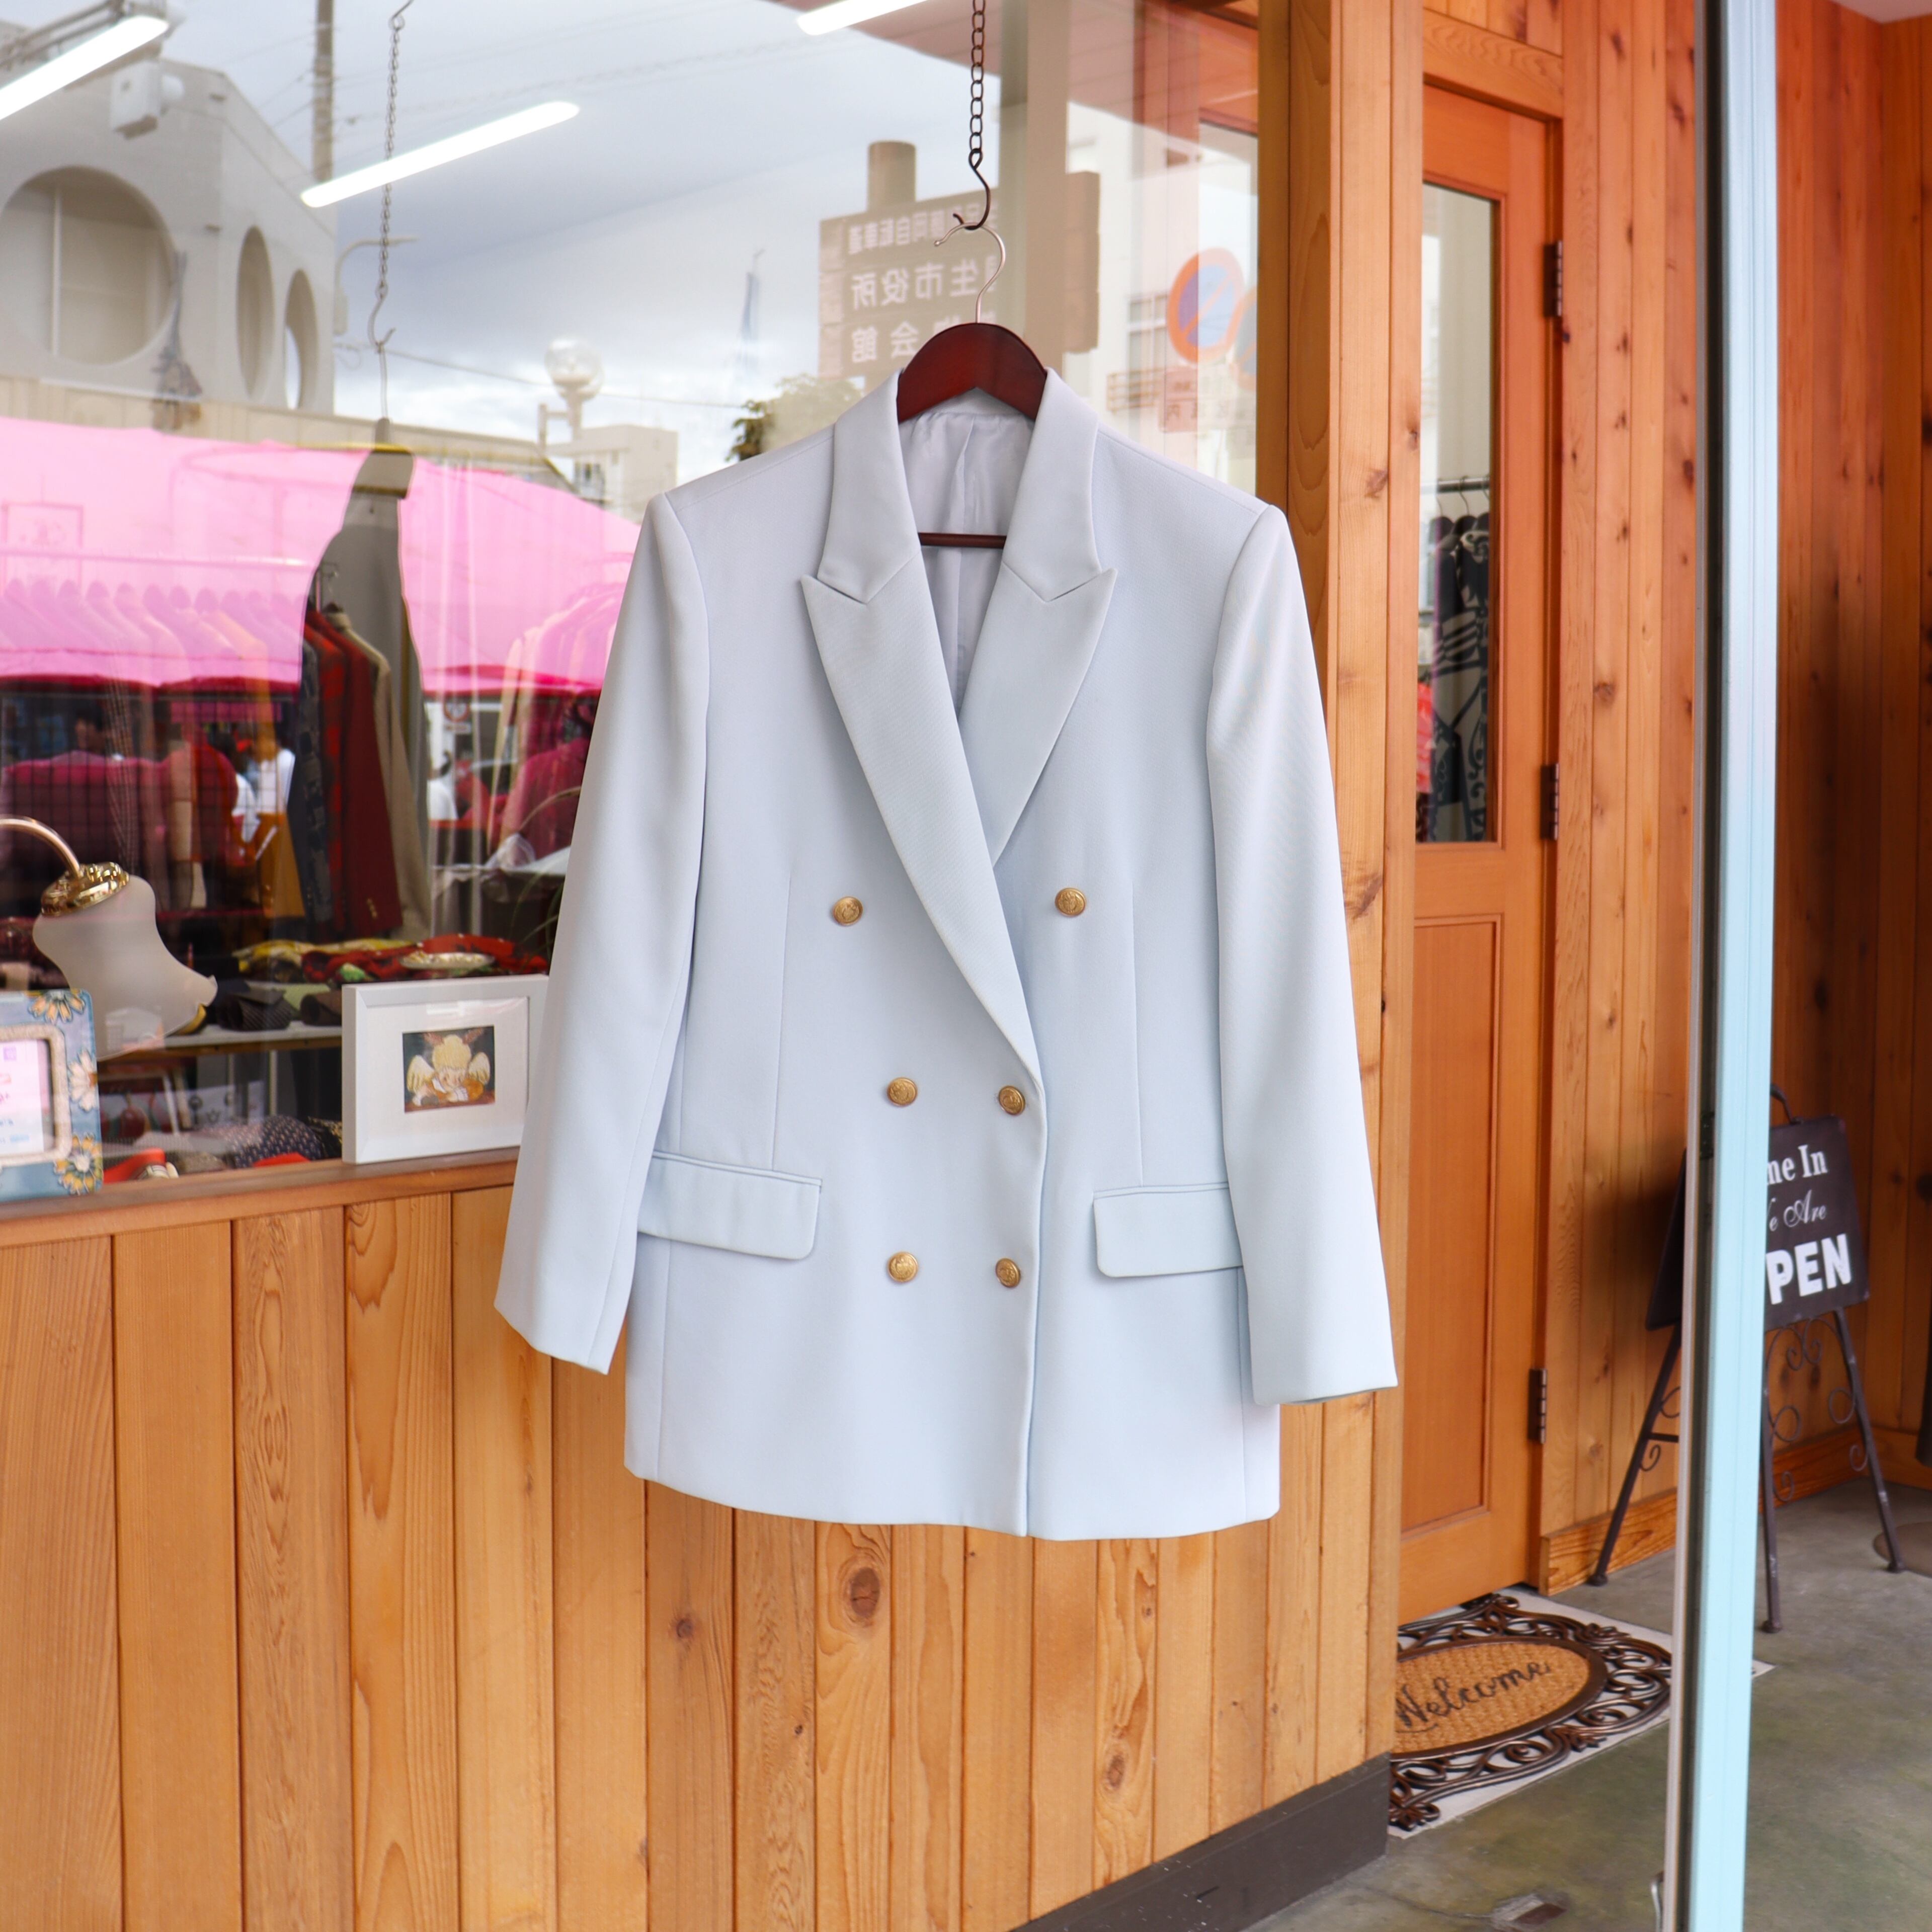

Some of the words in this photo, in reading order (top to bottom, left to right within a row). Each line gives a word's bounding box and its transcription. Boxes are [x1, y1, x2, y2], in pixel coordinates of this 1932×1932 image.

[1767, 1158, 1795, 1185] me
[1798, 1145, 1828, 1178] In
[1767, 1197, 1778, 1232] e
[1784, 1189, 1826, 1227] Are
[1766, 1234, 1852, 1305] PEN
